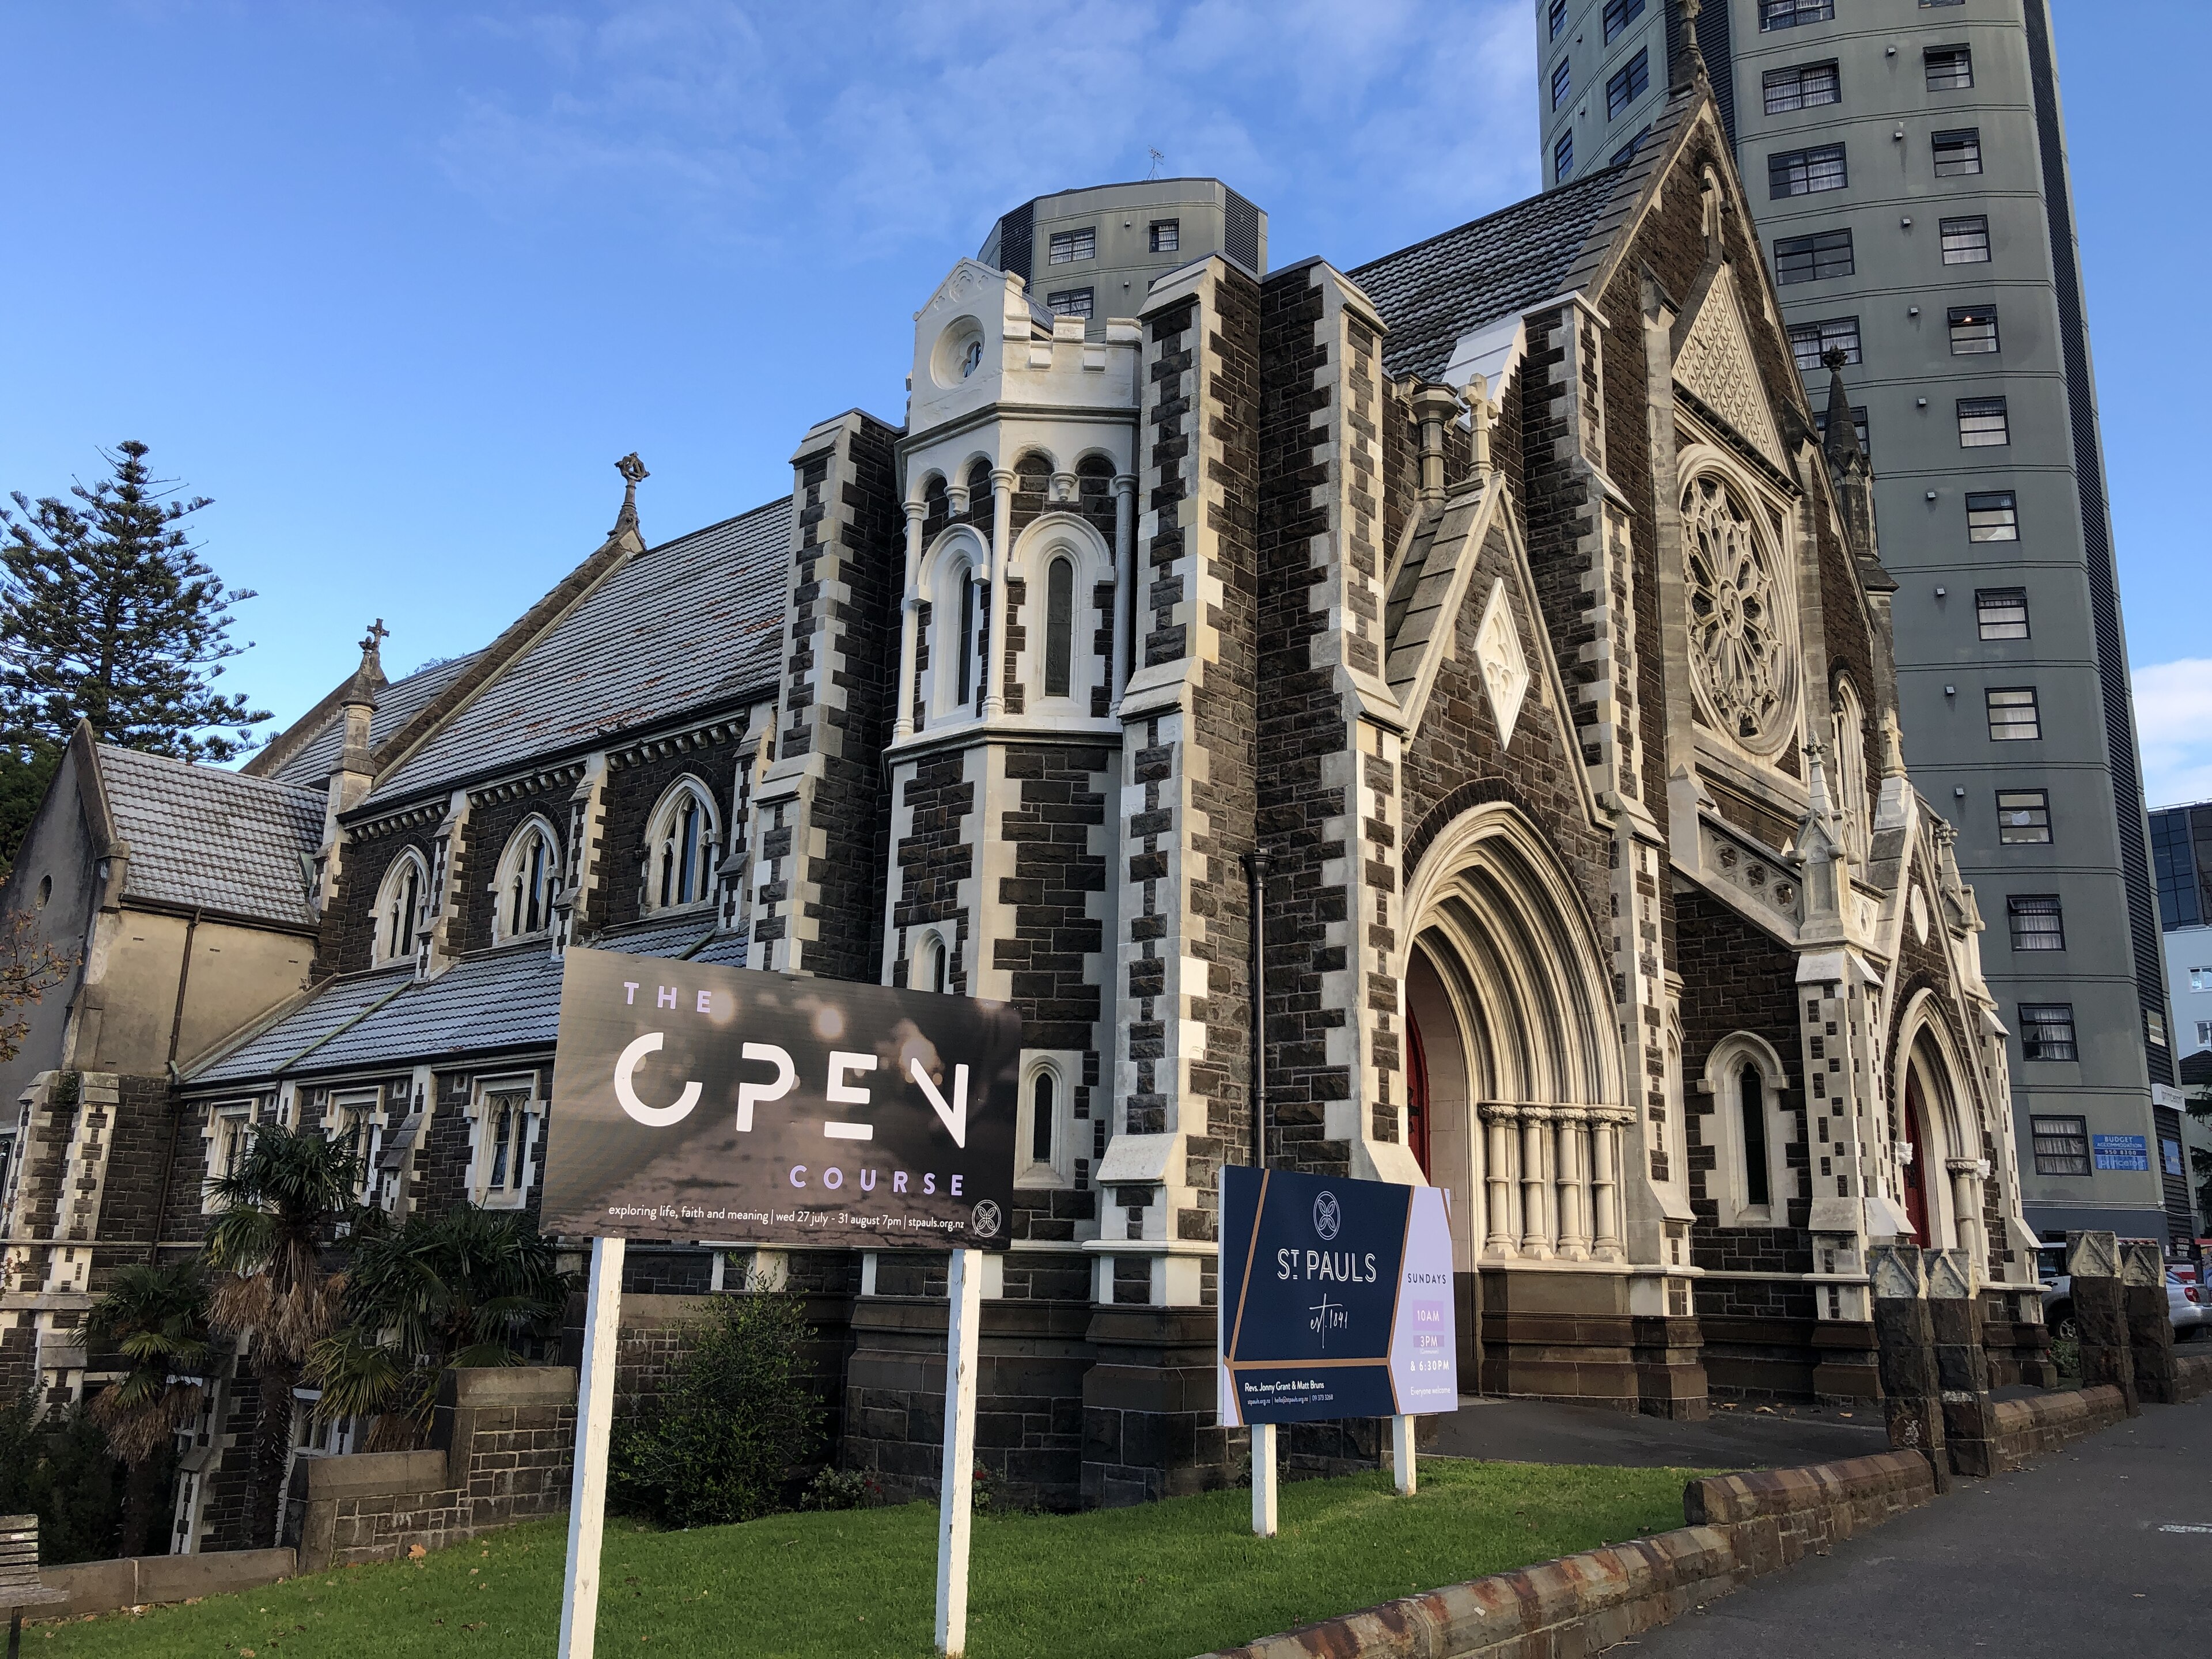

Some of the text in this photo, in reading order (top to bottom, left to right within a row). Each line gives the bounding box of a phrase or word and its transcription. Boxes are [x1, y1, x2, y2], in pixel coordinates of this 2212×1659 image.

[624, 982, 711, 1014] THE
[614, 1032, 969, 1149] OPEN
[789, 1165, 963, 1196] COURSE
[608, 1203, 657, 1220] exploring
[660, 1205, 678, 1219] life,
[681, 1206, 704, 1218] faith
[707, 1207, 725, 1219] and
[728, 1209, 768, 1225] meaning
[776, 1210, 794, 1222] wed
[797, 1211, 810, 1222] 27
[809, 1211, 828, 1227] july
[838, 1213, 848, 1224] 31
[850, 1215, 880, 1229] august
[882, 1214, 902, 1229] 7pm
[908, 1217, 964, 1232] stpauls.org.nz
[1306, 1249, 1377, 1283] PAULS
[1407, 1272, 1446, 1285] SUNDAYS
[1417, 1309, 1440, 1322] 10AM
[1420, 1335, 1438, 1347] 3PM
[1410, 1359, 1449, 1372] & 6:30PM
[1245, 1380, 1324, 1394] Revs. Jonny Grant & Matt Bruns
[1410, 1385, 1451, 1398] Everyone welcome
